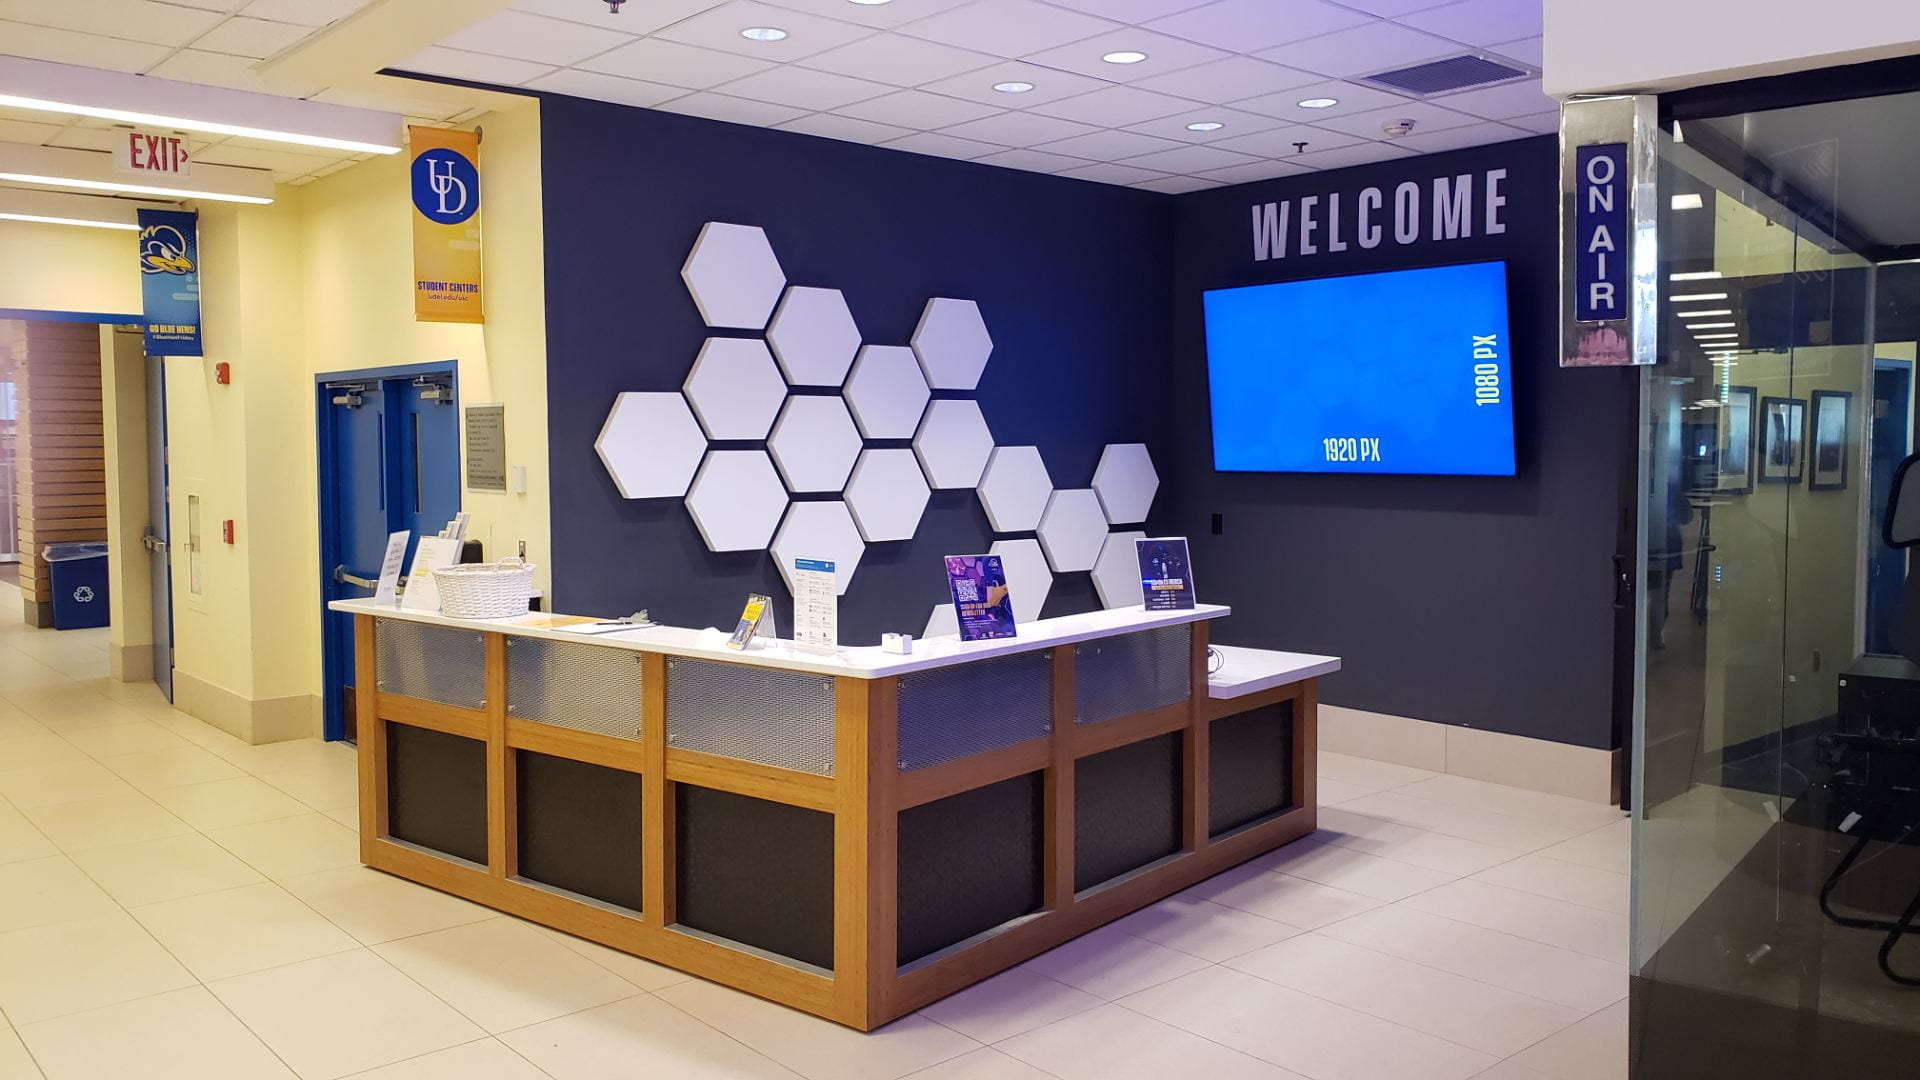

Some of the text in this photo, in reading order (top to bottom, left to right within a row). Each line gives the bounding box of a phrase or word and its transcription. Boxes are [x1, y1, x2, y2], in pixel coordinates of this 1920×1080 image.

[130, 133, 181, 172] EXIT
[426, 158, 467, 214] UD
[1251, 168, 1507, 262] WELCOME
[1586, 155, 1616, 310] ON AIR
[417, 281, 479, 294] STUDENT CENTERS
[428, 294, 469, 302] udel.edu/usc
[149, 324, 159, 333] GO
[160, 324, 176, 334] BLUE
[1472, 334, 1500, 407] 1080 PX
[1323, 437, 1381, 462] 1920 PX
